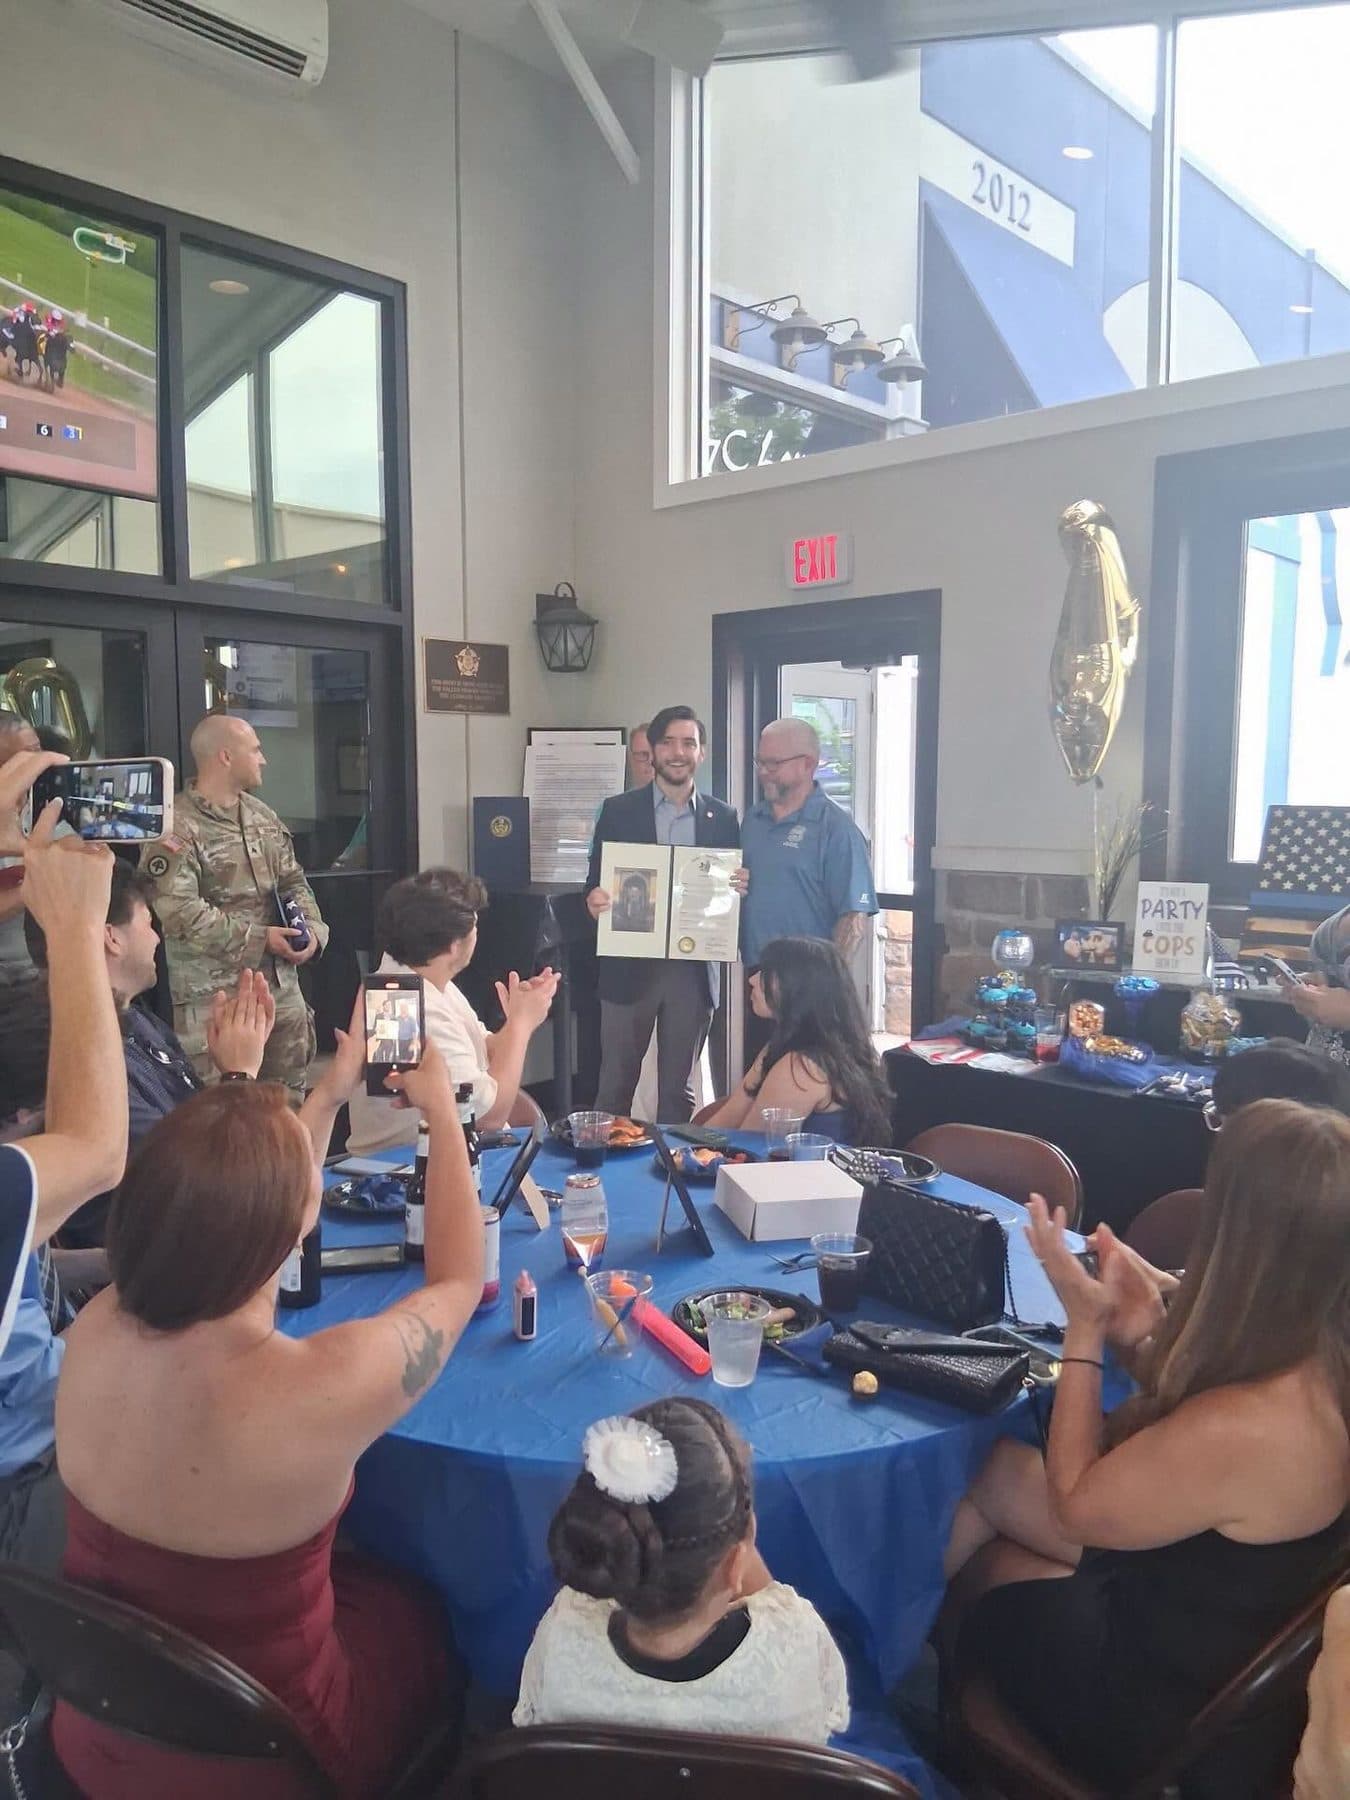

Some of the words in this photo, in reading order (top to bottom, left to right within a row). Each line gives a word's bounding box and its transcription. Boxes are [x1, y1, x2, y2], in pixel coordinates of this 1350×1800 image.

[971, 161, 1031, 232] 2012
[40, 424, 49, 436] 6
[794, 535, 838, 584] EXIT
[1141, 898, 1204, 920] PARTY
[1142, 935, 1197, 957] COPS
